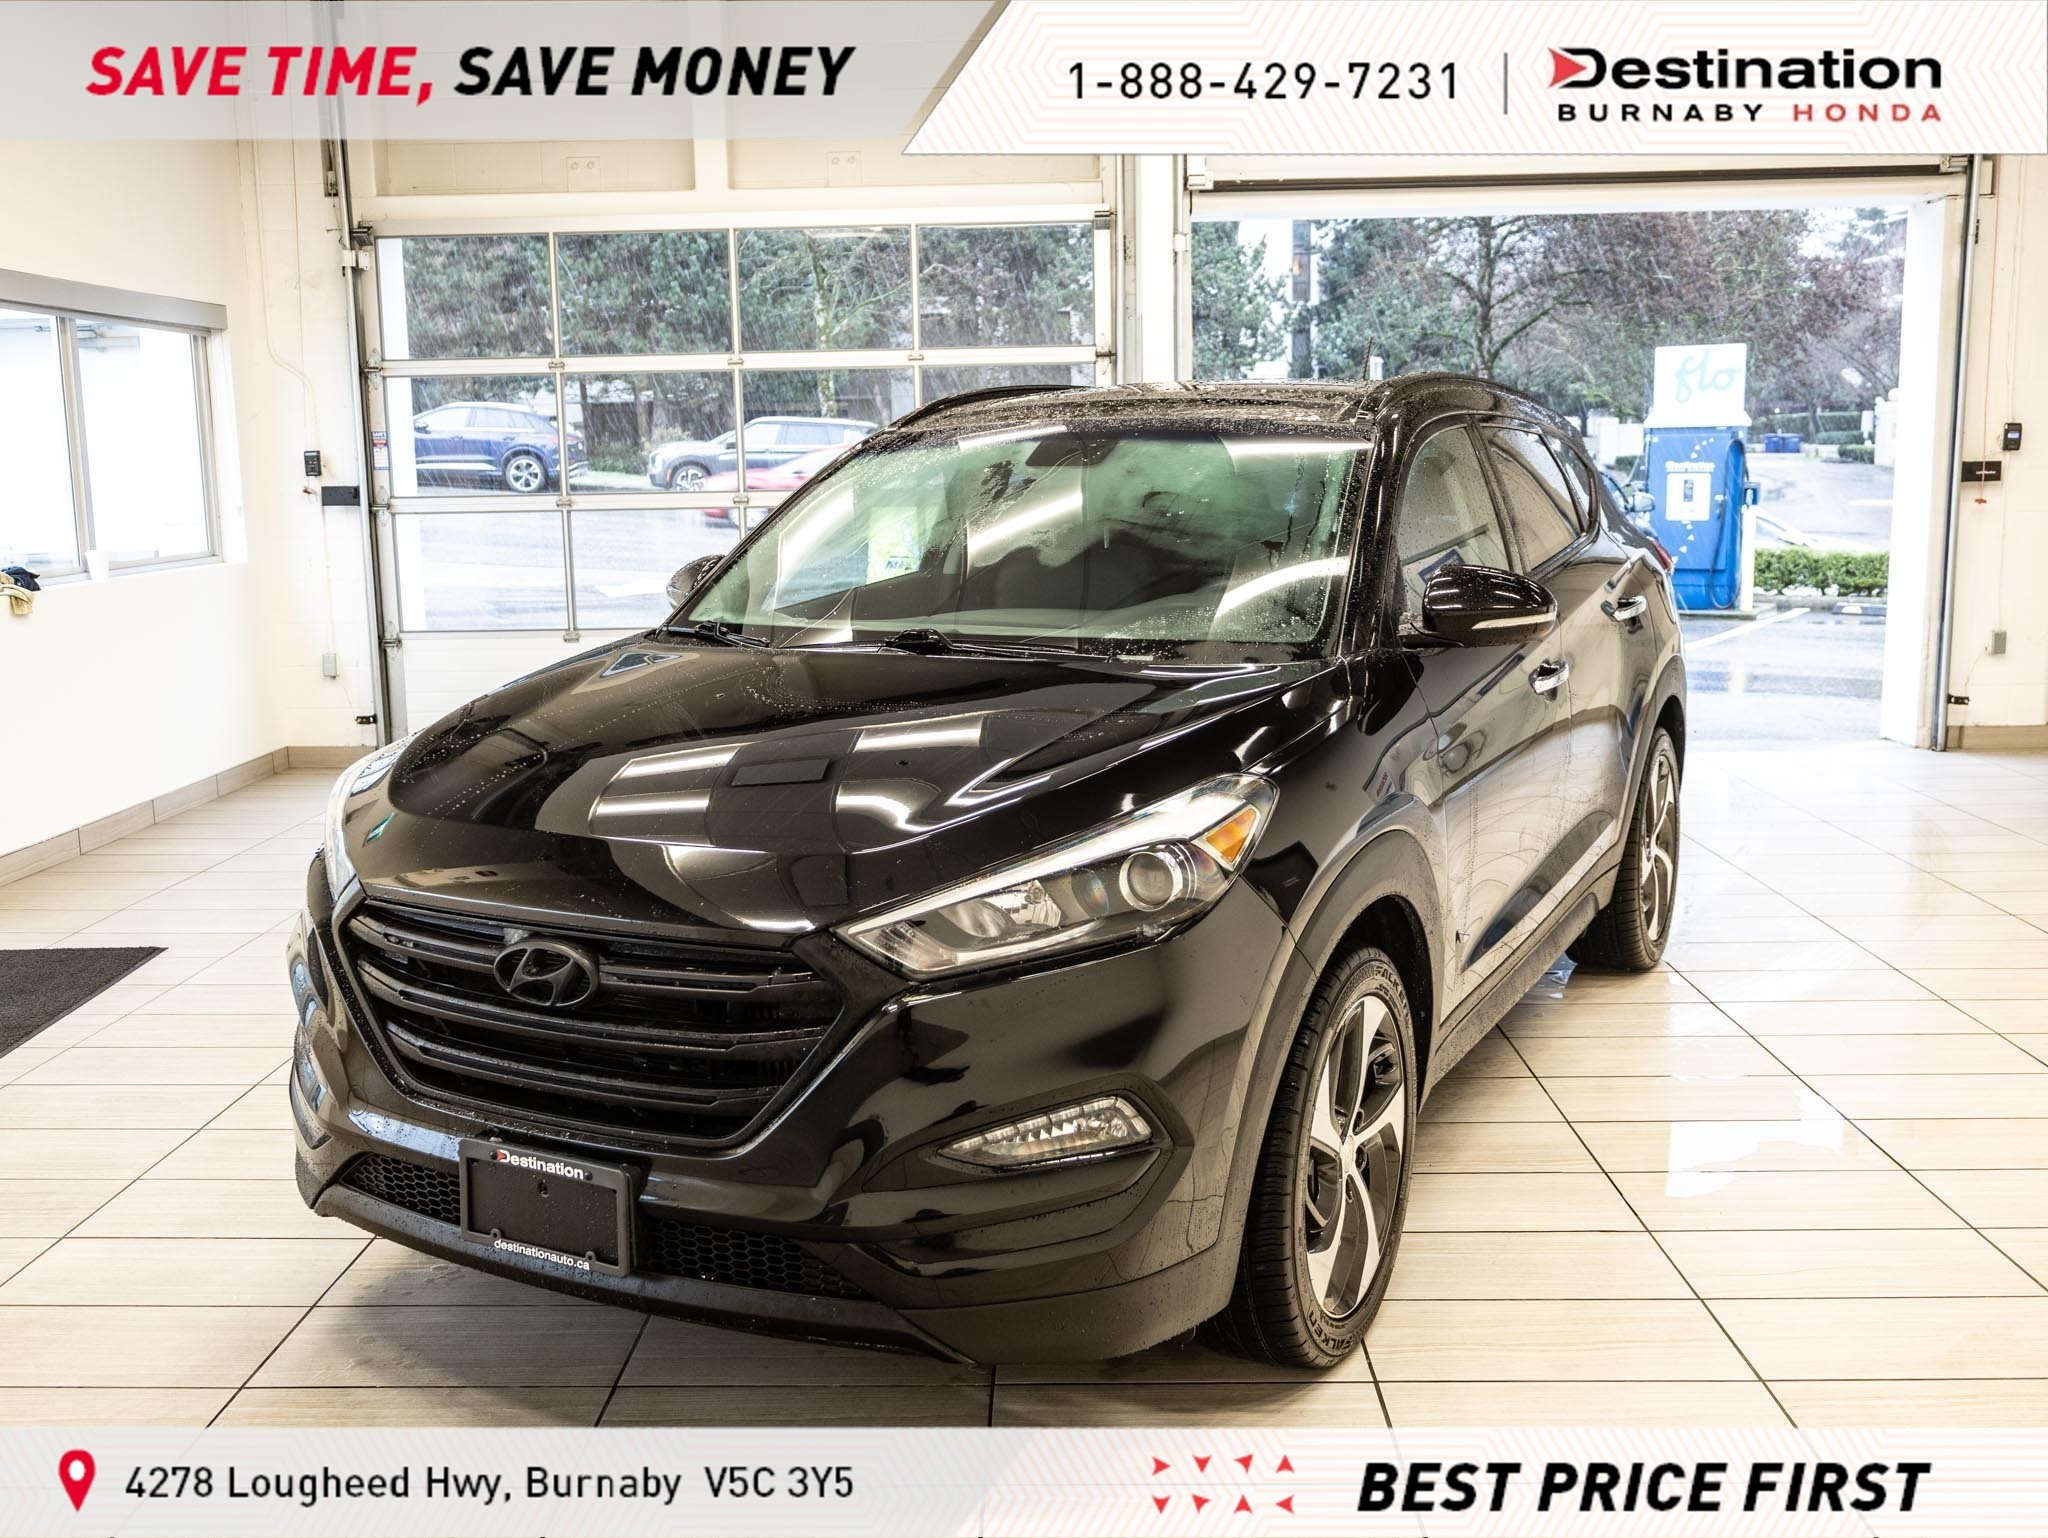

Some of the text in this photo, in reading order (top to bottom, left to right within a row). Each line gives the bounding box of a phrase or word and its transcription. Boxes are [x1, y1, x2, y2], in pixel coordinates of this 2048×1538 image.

[1675, 349, 1741, 403] flo
[496, 1149, 584, 1180] Destination
[494, 1240, 590, 1271] destinationauto.ca
[1308, 1310, 1353, 1350] FALKEN
